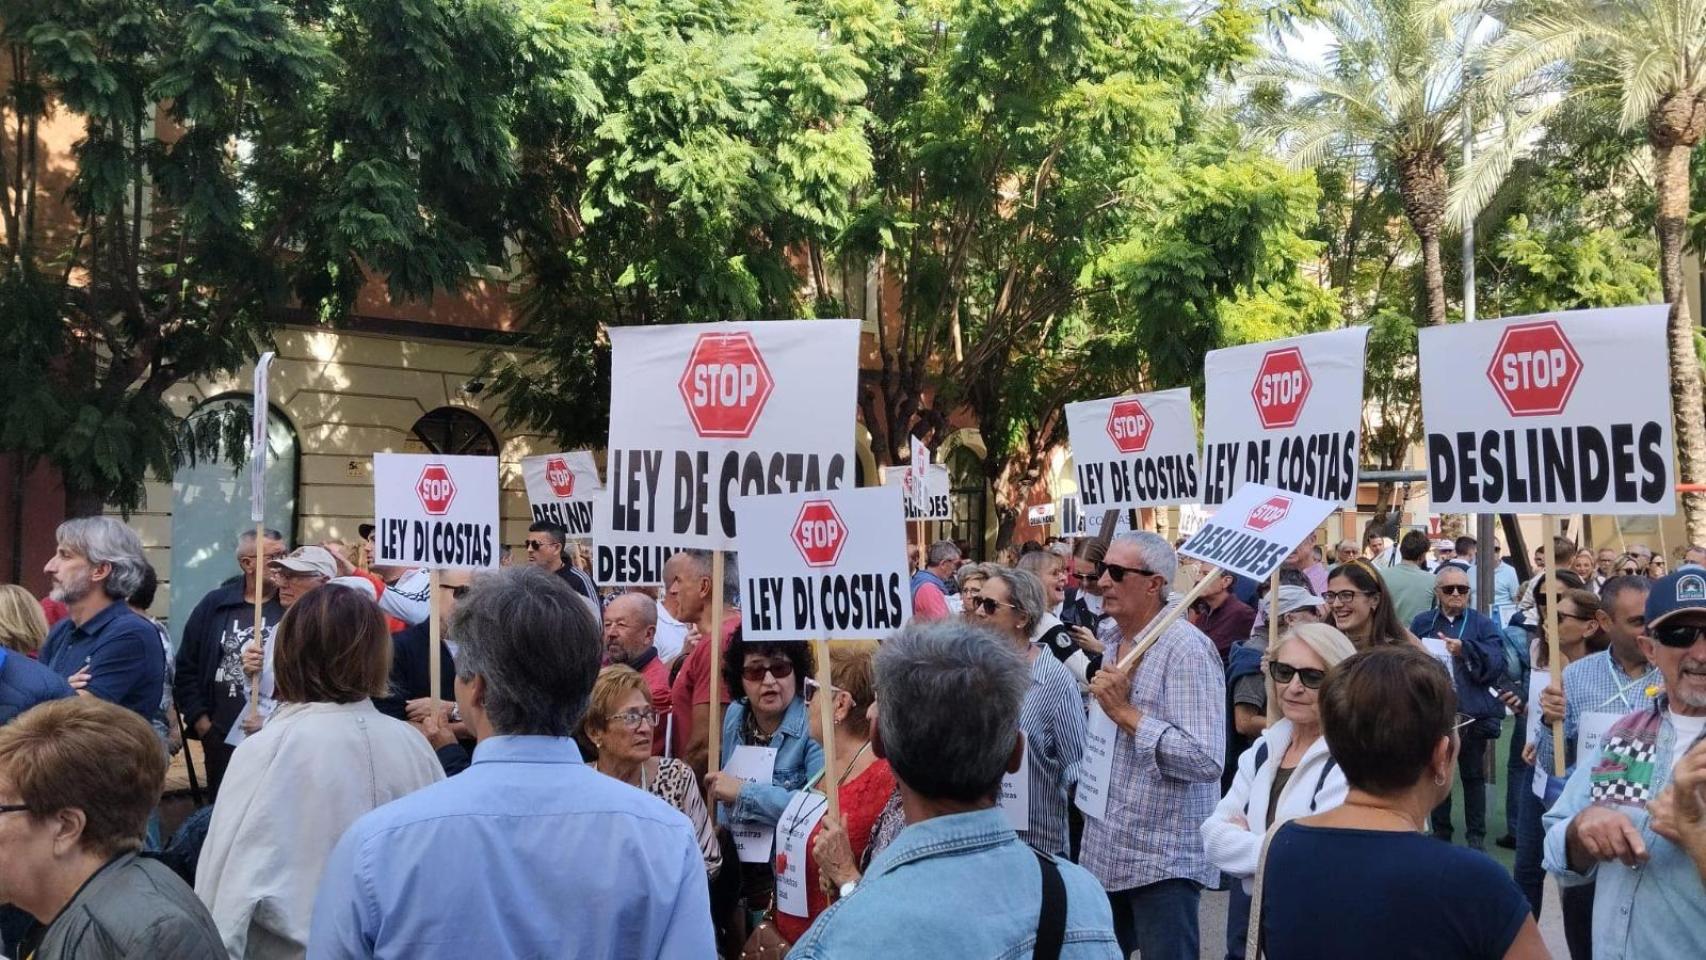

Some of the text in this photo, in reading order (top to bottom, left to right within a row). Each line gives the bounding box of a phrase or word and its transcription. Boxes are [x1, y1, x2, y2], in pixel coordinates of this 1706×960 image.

[694, 363, 757, 408] STOP
[1261, 371, 1302, 406] STOP
[1502, 349, 1566, 391] STOP
[1113, 416, 1146, 439] STOP
[1078, 453, 1198, 505] LEY DE COSTAS
[1204, 430, 1355, 505] LEY DE COSTAS
[1428, 421, 1667, 504] DESLINDES
[423, 478, 449, 501] SOP
[612, 450, 662, 533] LEY
[673, 451, 709, 535] DE
[1252, 504, 1287, 523] STOP
[381, 518, 408, 560] LEY
[433, 521, 491, 567] COSTAS
[1185, 524, 1288, 577] DESLINDES
[749, 578, 784, 632] LEY
[820, 573, 903, 631] COSTAS
